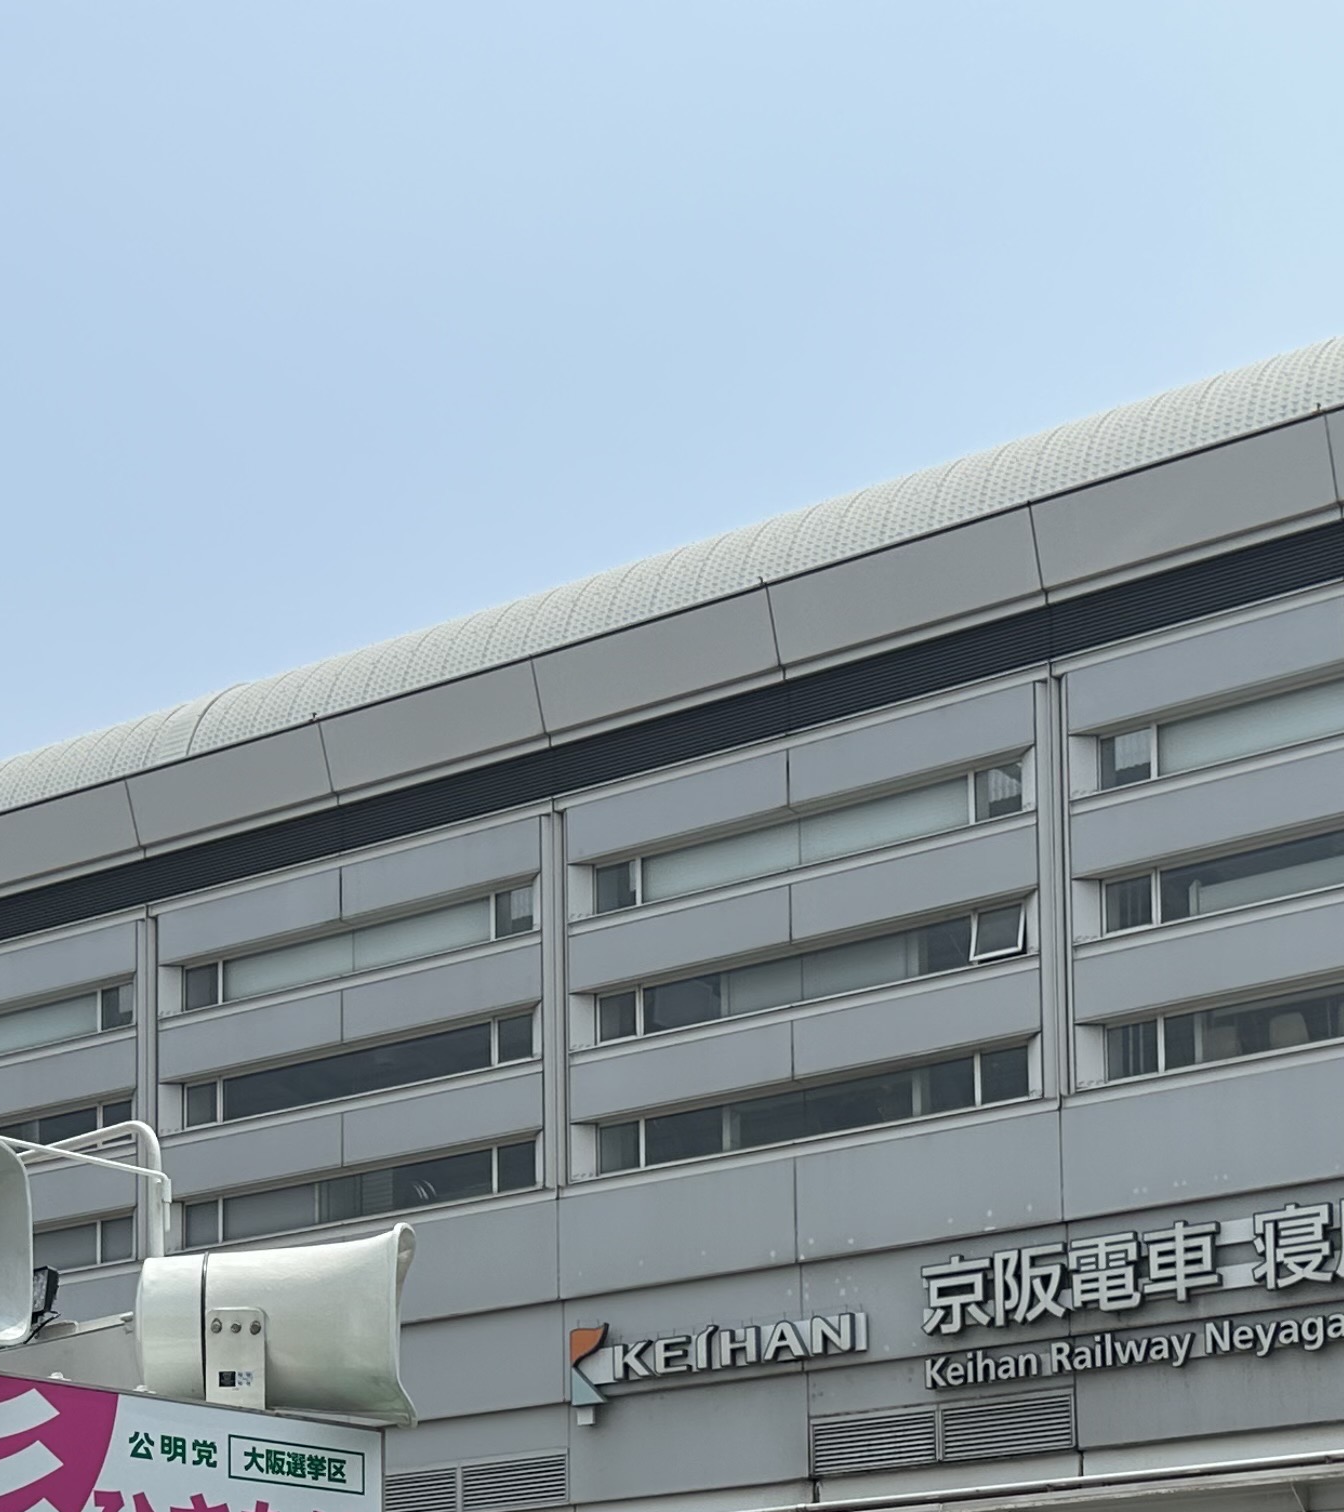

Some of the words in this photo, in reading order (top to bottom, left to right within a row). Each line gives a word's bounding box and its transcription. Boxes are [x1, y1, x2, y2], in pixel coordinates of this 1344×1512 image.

[919, 1220, 1222, 1337] 京阪電車
[611, 1311, 862, 1382] KEIHAN
[924, 1351, 1040, 1391] Keihan
[1049, 1330, 1196, 1374] Railway
[128, 1431, 218, 1469] 公明党
[242, 1443, 349, 1485] 大阪選挙区
